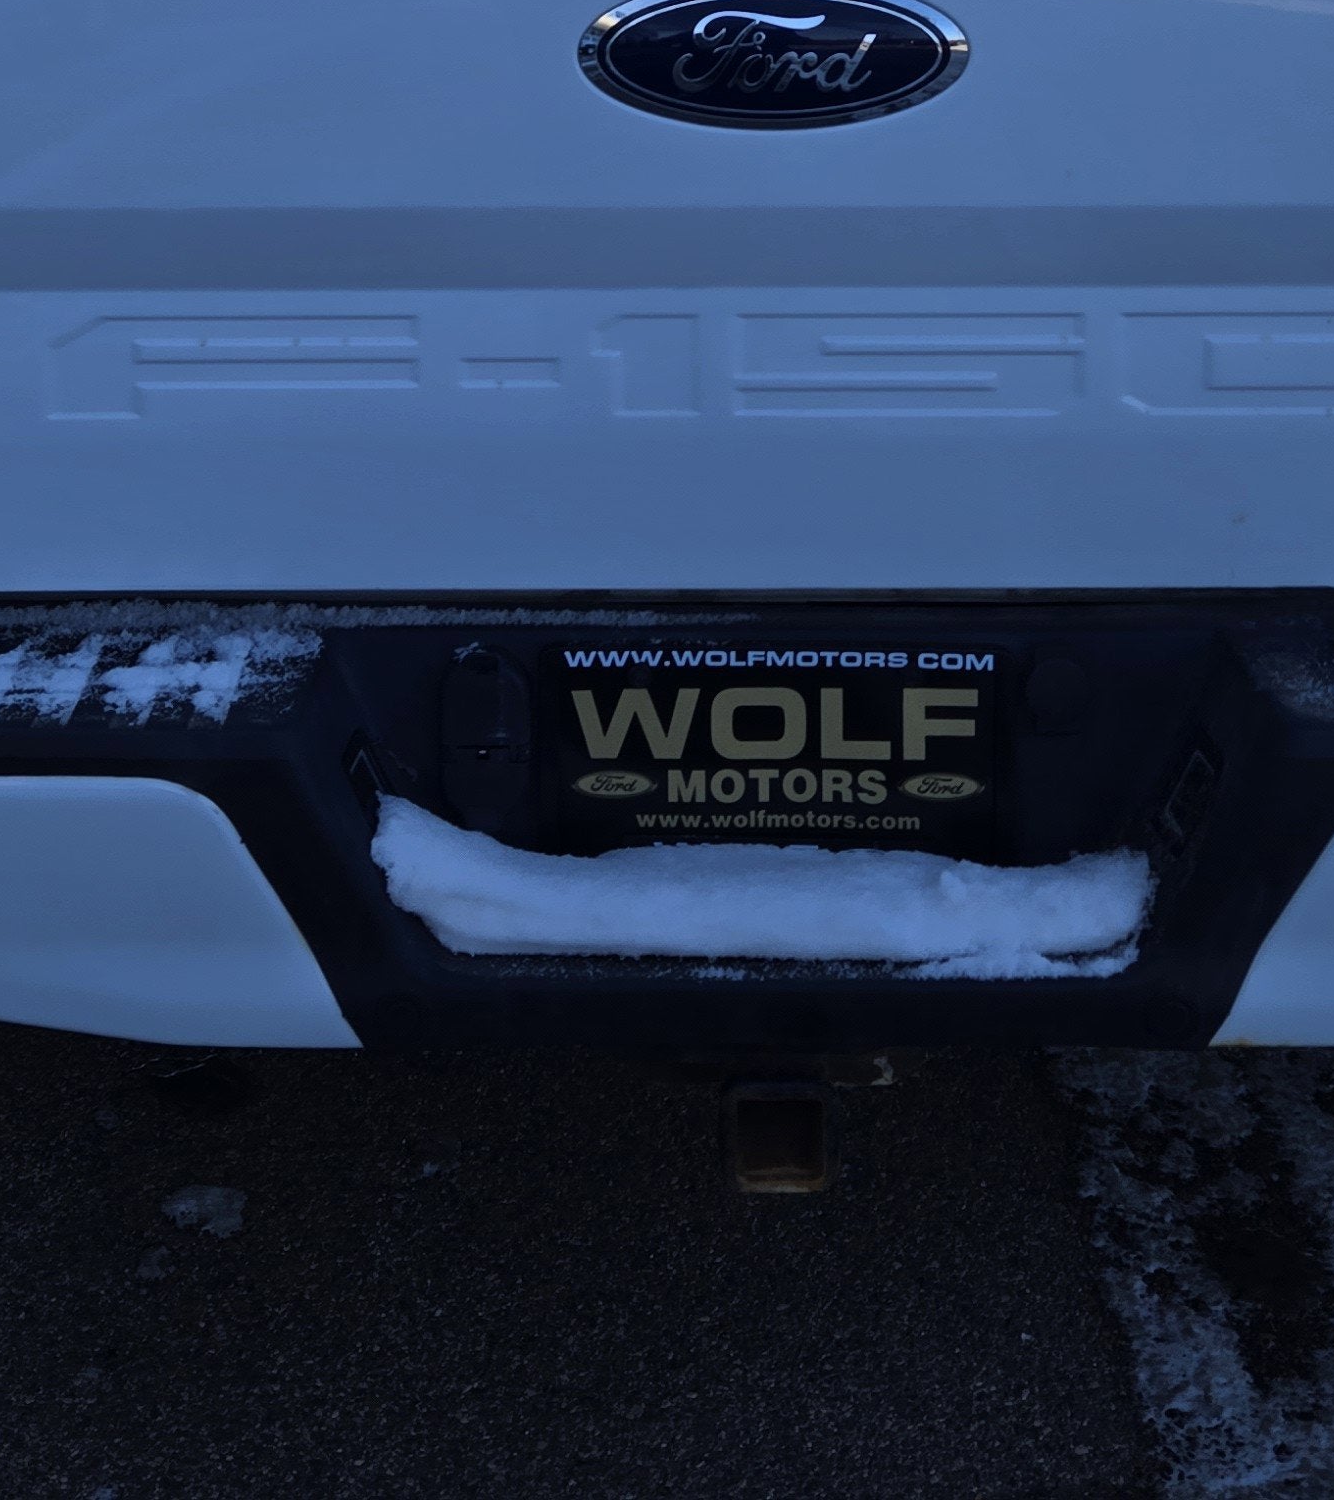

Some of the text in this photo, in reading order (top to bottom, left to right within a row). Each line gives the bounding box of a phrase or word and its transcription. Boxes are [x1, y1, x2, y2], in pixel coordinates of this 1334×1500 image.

[672, 10, 877, 93] Ford
[571, 687, 979, 761] WOLF
[590, 768, 965, 804] Ford MOTORS Ford
[636, 810, 921, 831] www.wolfmotors.com
